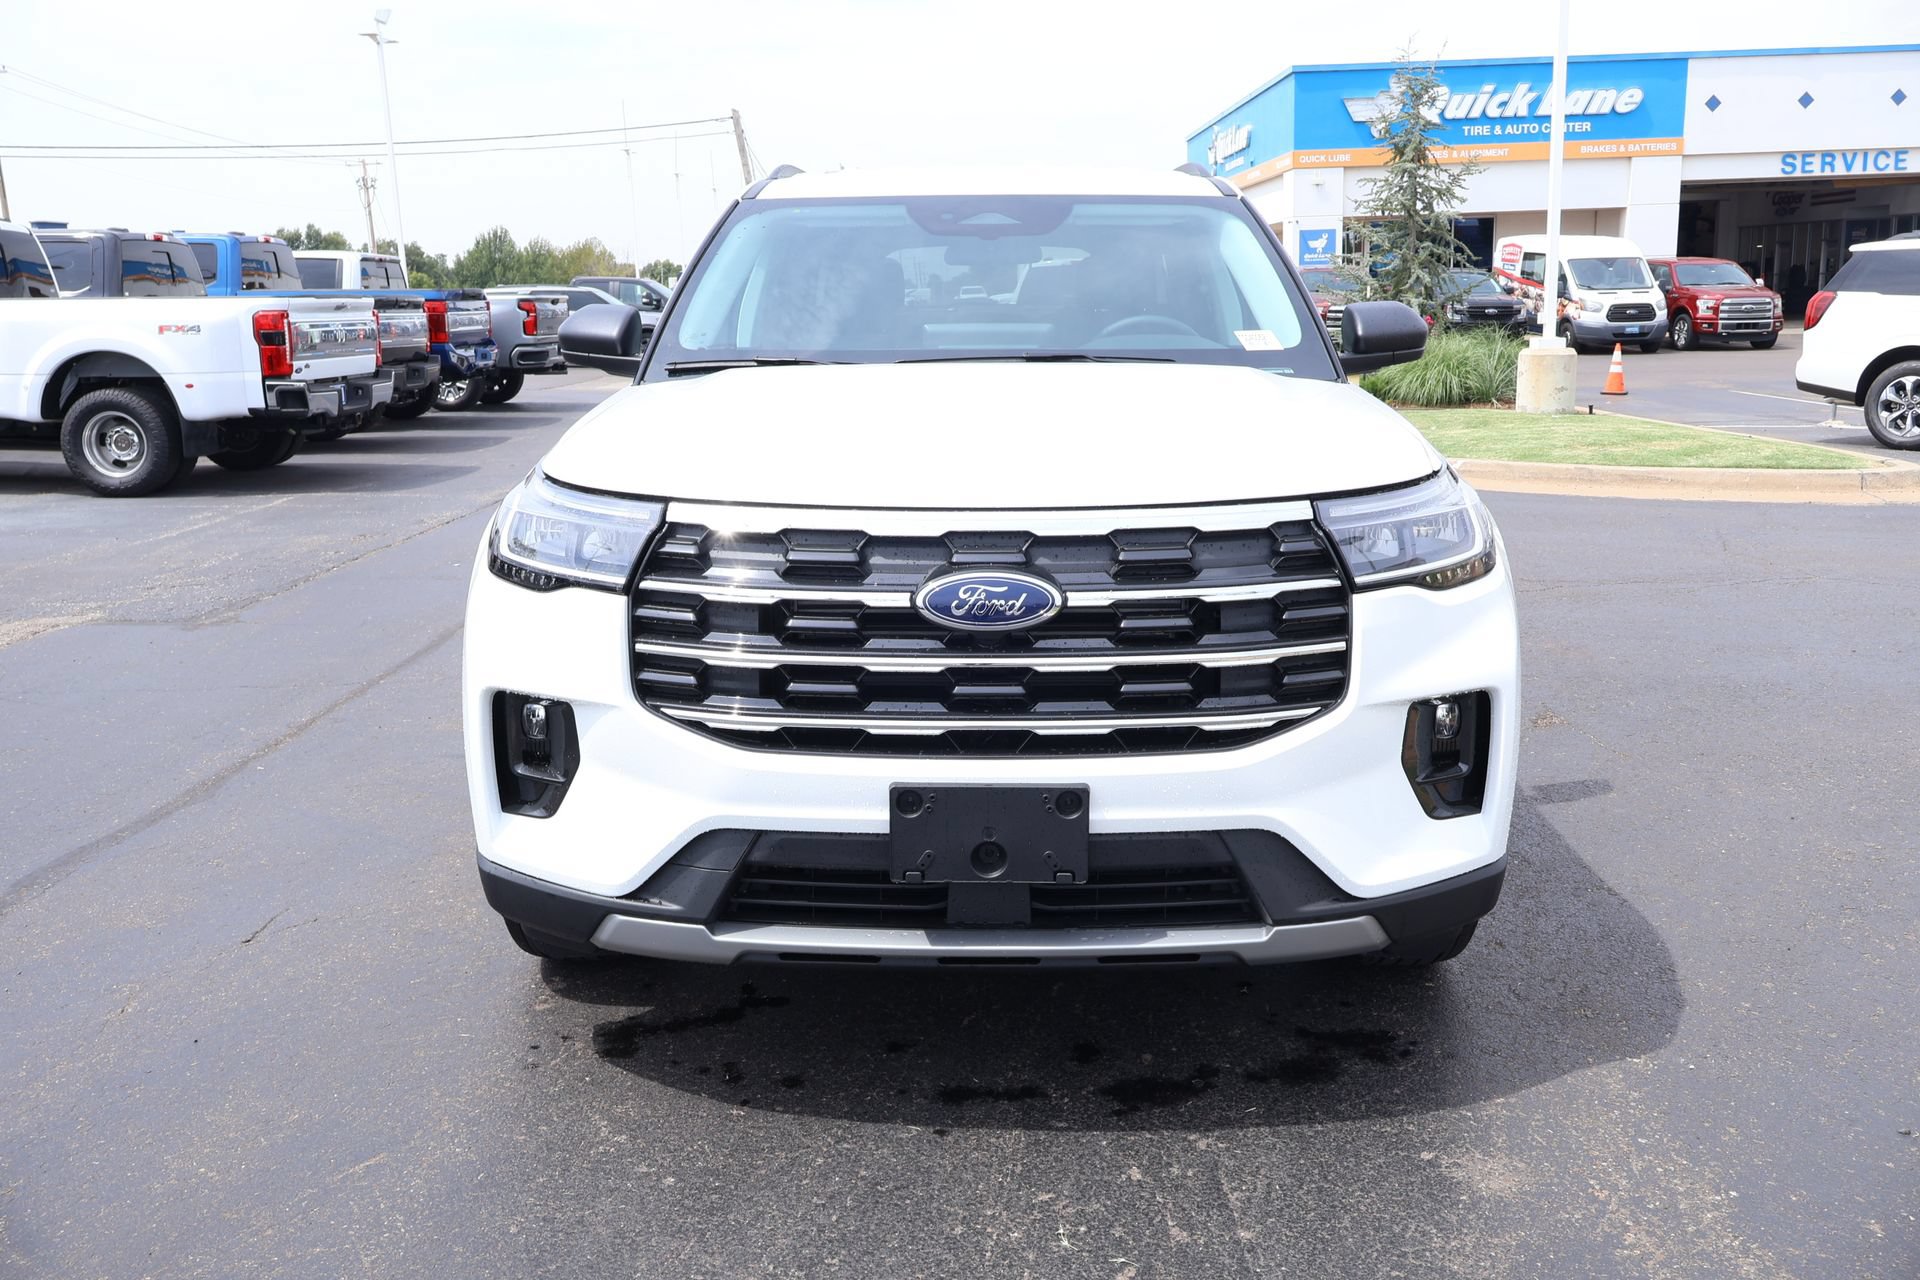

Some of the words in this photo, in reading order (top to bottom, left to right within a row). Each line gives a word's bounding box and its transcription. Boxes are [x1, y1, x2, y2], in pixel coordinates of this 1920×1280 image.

[1463, 125, 1490, 136] TIRE
[1495, 125, 1502, 135] &
[1505, 123, 1539, 135] AUTO
[1541, 121, 1592, 134] CTER
[1581, 144, 1617, 153] BRAKES
[1628, 143, 1677, 152] BATTERIES
[1299, 154, 1327, 164] QUICK
[1328, 153, 1352, 162] LUBE
[1781, 150, 1909, 175] SERVICE
[158, 324, 201, 335] FX4
[951, 584, 1028, 616] Ford
